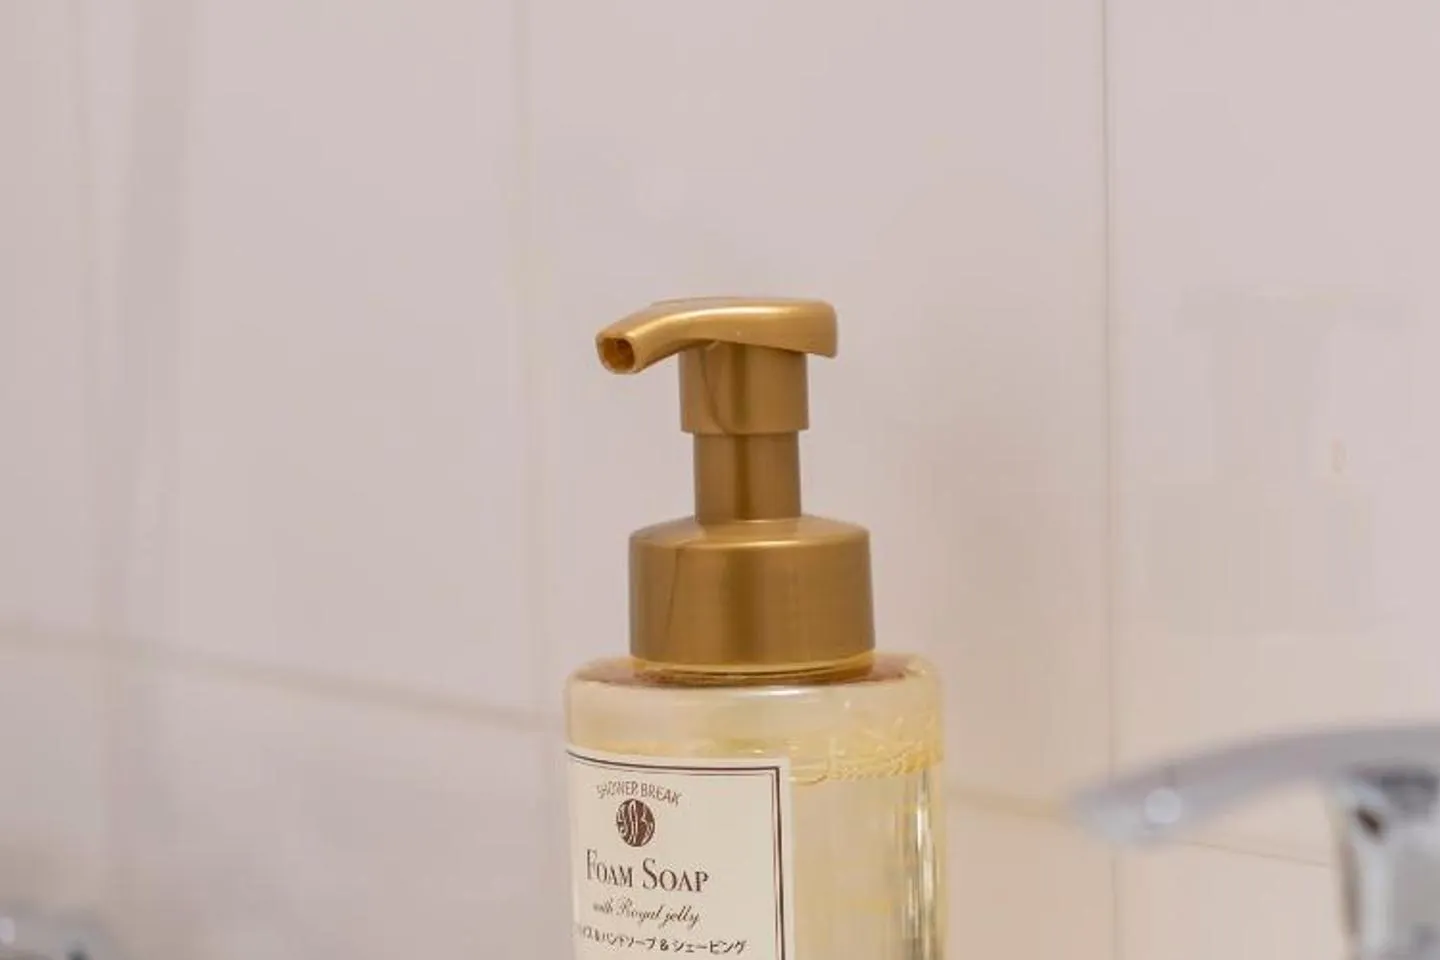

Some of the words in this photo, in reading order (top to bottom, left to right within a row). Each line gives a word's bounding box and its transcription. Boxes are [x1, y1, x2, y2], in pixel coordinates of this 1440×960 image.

[640, 783, 682, 807] BREAK
[586, 848, 633, 888] FOAM
[642, 857, 709, 892] SOAP
[617, 896, 665, 926] Royal
[658, 905, 700, 930] jelly
